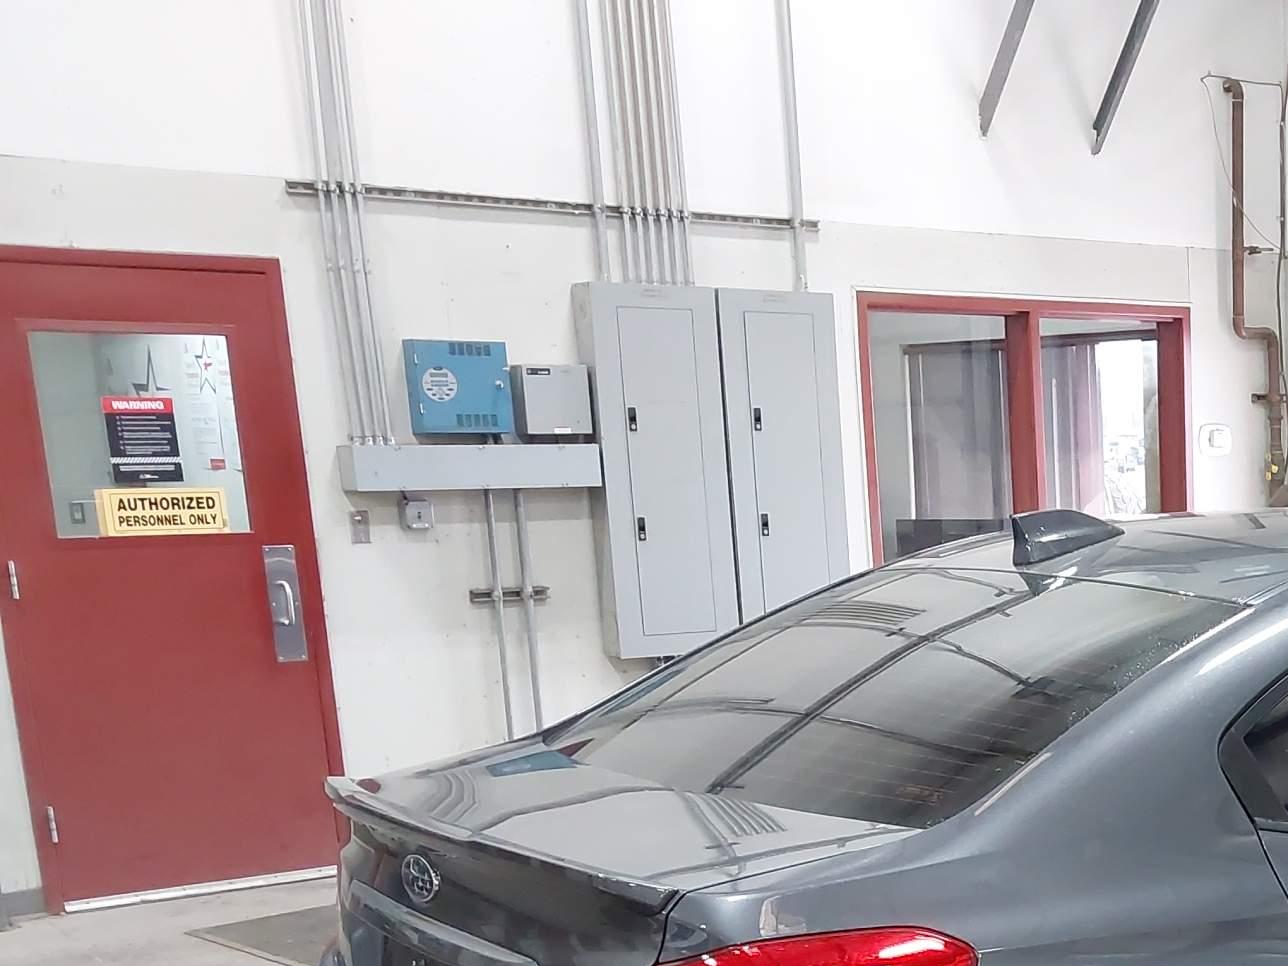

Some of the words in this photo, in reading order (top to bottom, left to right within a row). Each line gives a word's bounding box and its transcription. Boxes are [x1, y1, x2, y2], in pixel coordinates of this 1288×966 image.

[111, 400, 165, 410] WARNING
[117, 496, 216, 511] AUTHORIZED
[118, 514, 186, 527] PERSONNEL
[188, 513, 218, 526] ONLY
